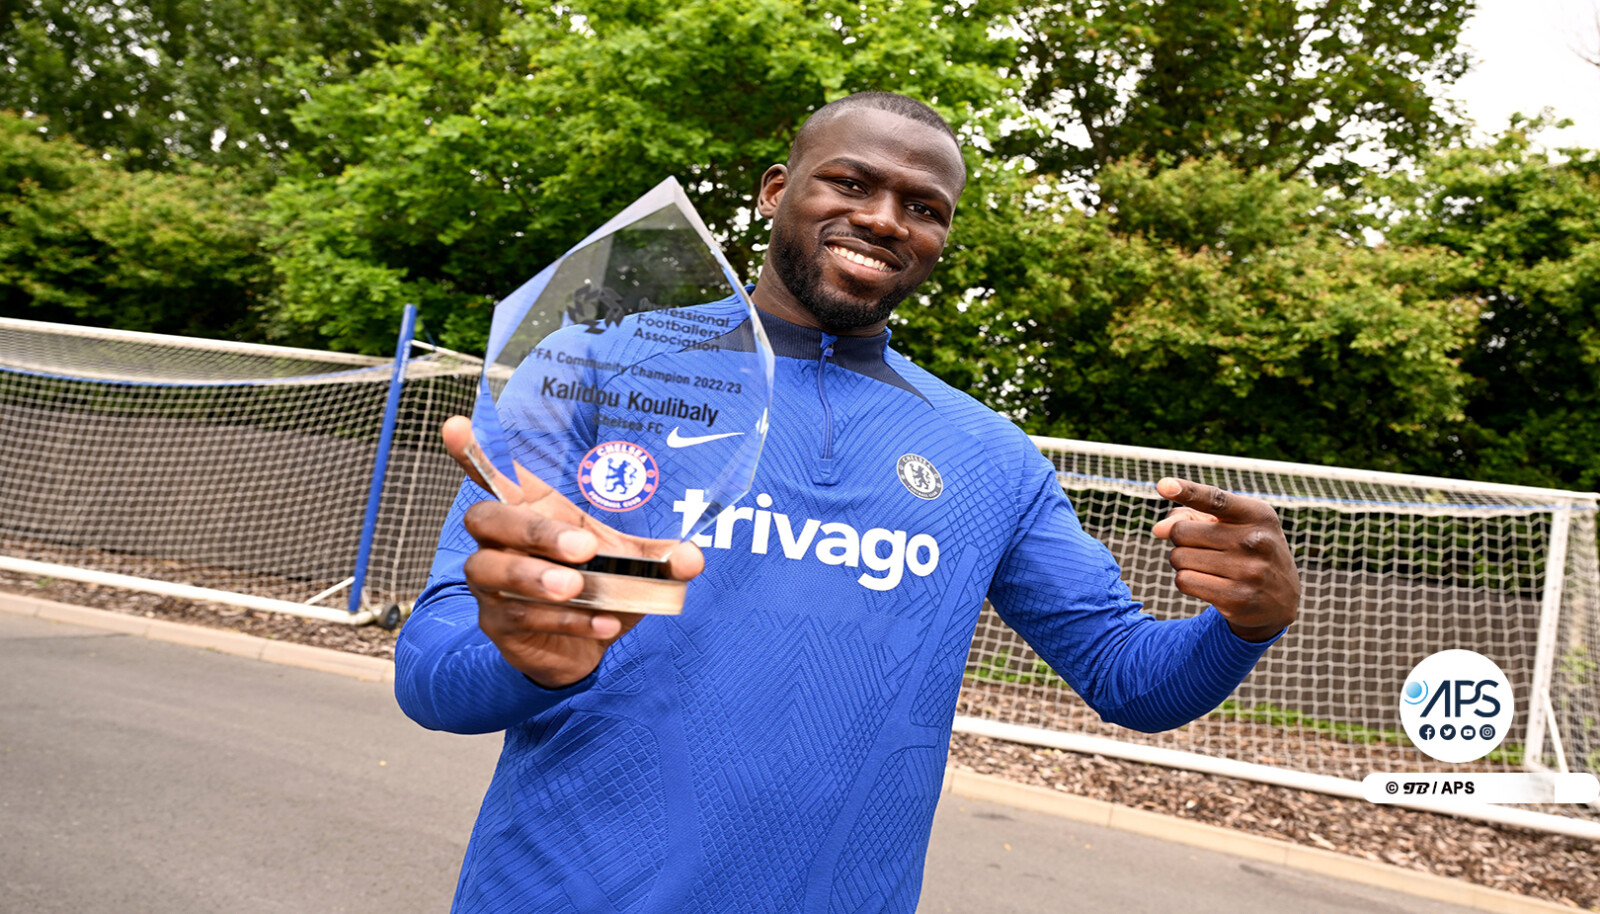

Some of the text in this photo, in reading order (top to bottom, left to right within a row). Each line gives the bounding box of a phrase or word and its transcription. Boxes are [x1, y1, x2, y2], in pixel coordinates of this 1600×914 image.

[633, 327, 720, 353] Association
[556, 351, 627, 376] Community
[630, 364, 691, 386] Champion
[694, 375, 742, 394] 2022/23
[541, 376, 719, 428] Kalidou Koulibaly
[647, 421, 665, 435] FC
[596, 443, 648, 465] CHELSEA
[673, 488, 940, 591] trivago
